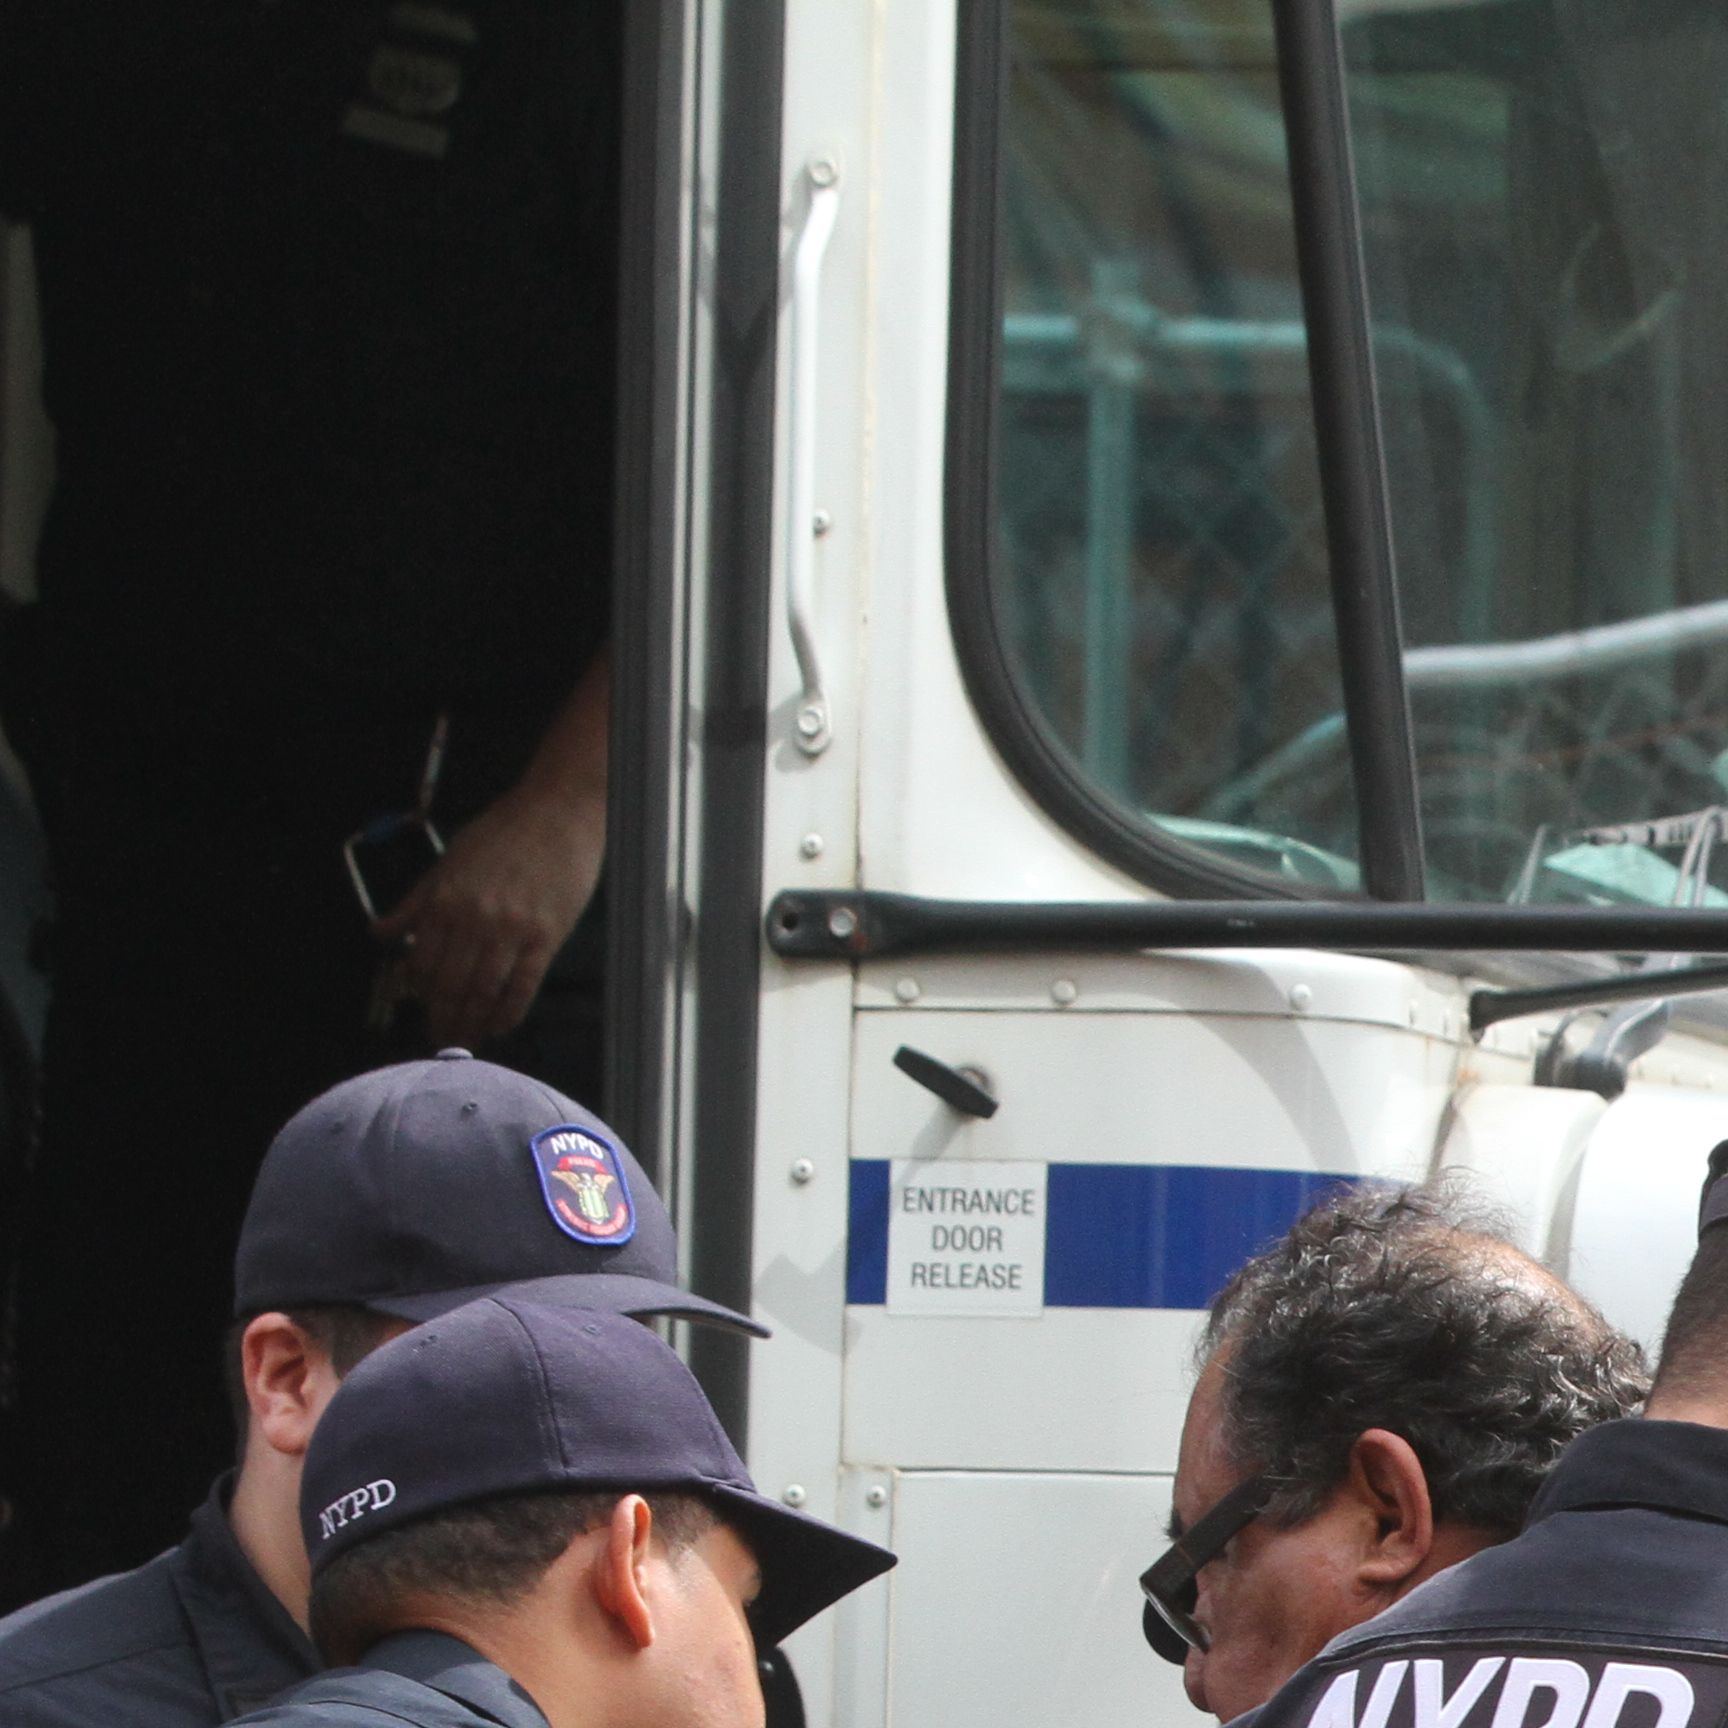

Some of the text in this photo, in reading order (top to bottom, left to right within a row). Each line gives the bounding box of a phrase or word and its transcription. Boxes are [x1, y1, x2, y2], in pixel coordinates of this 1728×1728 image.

[551, 1133, 604, 1159] NYPD
[903, 1187, 1035, 1214] ENTRANCE
[932, 1225, 1003, 1251] DOOR
[911, 1262, 1022, 1289] RELEASE
[319, 1479, 397, 1540] NYPD
